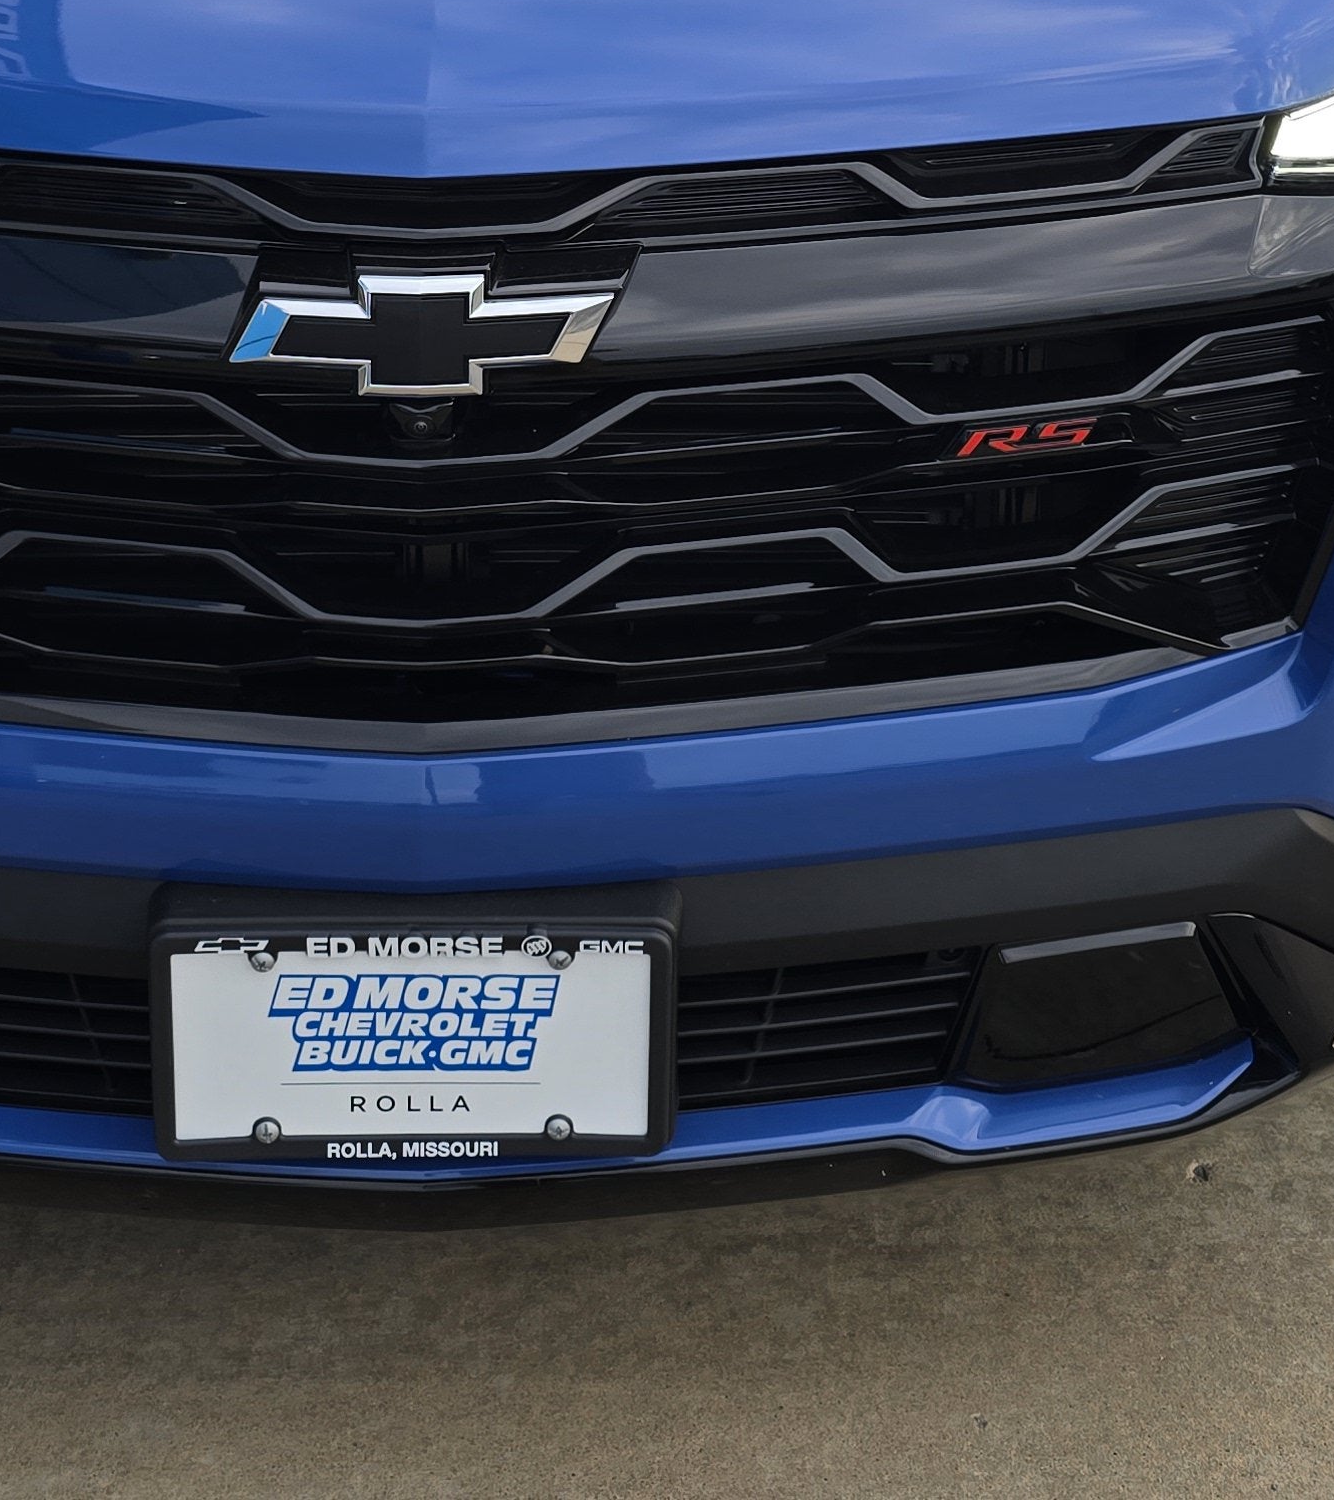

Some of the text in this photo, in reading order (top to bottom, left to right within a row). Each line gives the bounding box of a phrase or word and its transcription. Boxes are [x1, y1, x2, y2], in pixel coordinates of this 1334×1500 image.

[956, 417, 1098, 457] RS
[306, 936, 644, 959] ED MORSE GMC
[272, 976, 557, 1010] ED MORSE
[294, 1011, 535, 1038] CHEVROLET
[350, 1095, 470, 1112] ROLLA
[327, 1142, 499, 1161] ROLLA, MISSOURI
